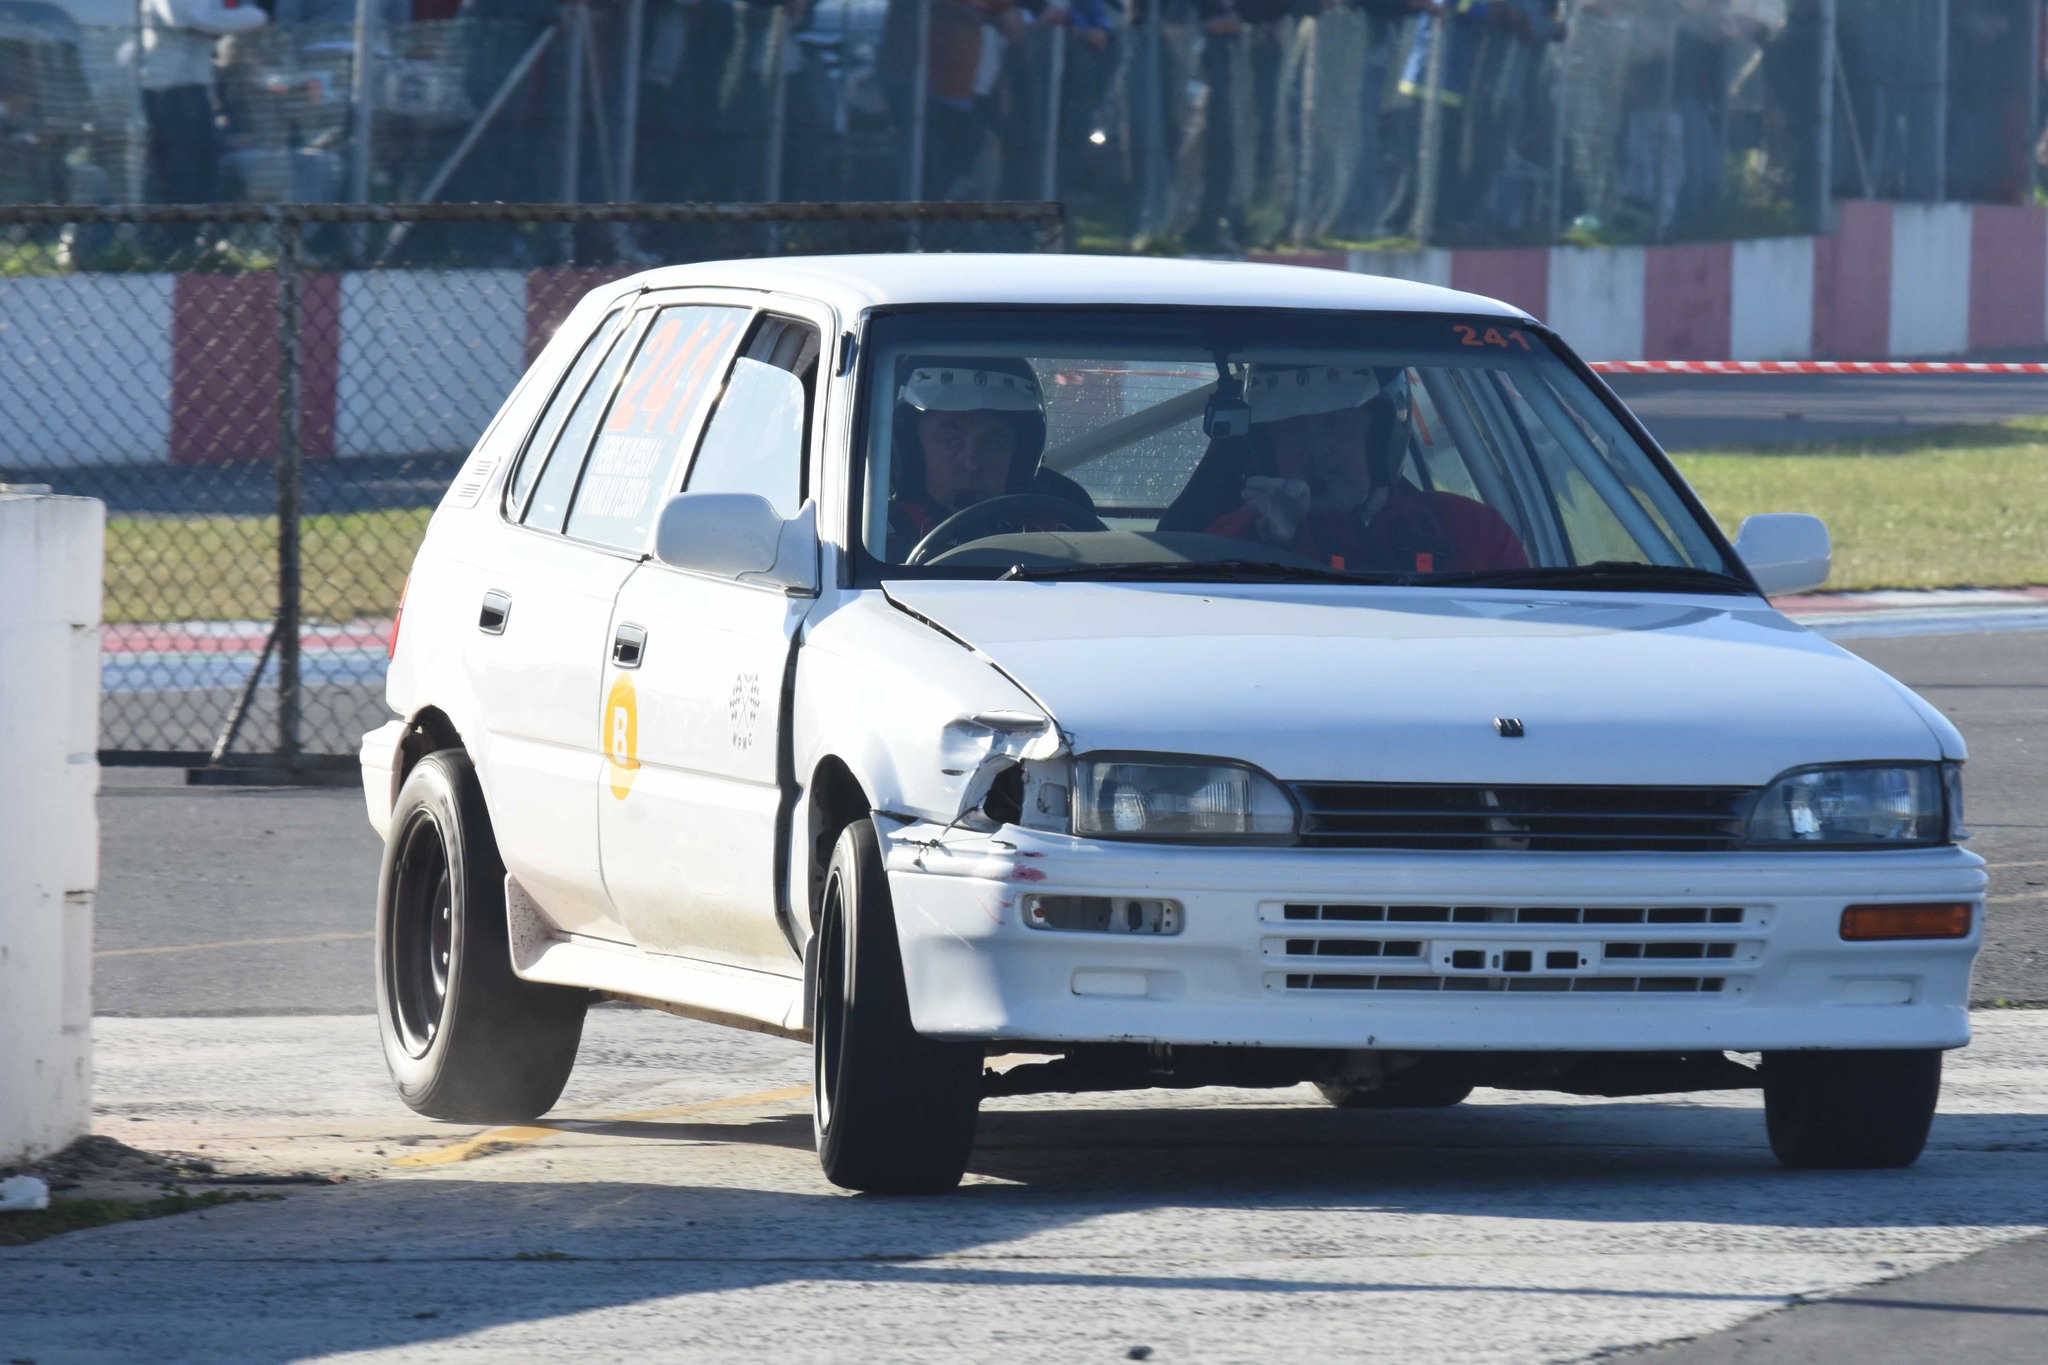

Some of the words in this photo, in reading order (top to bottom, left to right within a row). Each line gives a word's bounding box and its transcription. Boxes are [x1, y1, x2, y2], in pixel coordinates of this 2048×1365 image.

[1453, 325, 1532, 351] 241
[606, 319, 735, 434] 241
[613, 706, 628, 765] B
